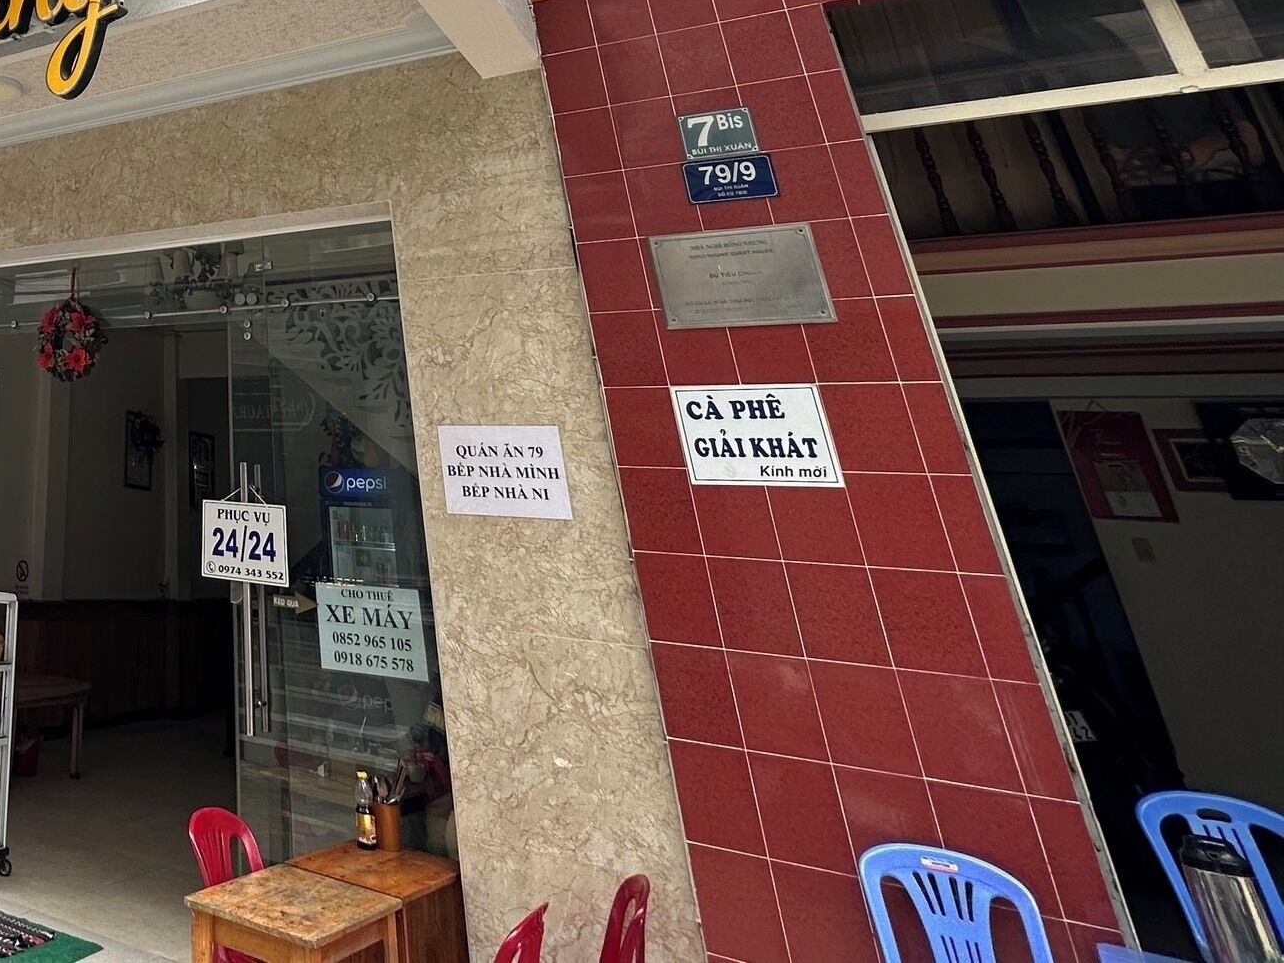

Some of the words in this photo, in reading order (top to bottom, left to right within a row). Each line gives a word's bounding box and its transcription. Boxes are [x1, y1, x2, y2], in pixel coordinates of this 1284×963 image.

[687, 115, 714, 147] 7
[716, 112, 744, 130] Bis
[698, 161, 756, 185] 79/9
[686, 395, 724, 420] CÀ
[729, 393, 785, 419] PHÊ
[456, 442, 498, 460] QUÁN
[503, 443, 524, 458] ĂN
[528, 446, 544, 458] 79
[694, 428, 747, 458] GIẢI
[748, 431, 818, 458] KHÁT
[447, 461, 474, 477] BẾP
[479, 463, 512, 478] NHÀ
[516, 464, 560, 479] MÌNH
[760, 465, 794, 477] Kính
[799, 466, 827, 478] mời
[346, 477, 386, 493] pepsi
[462, 482, 490, 498] BẾP
[494, 484, 528, 500] NHÀ
[533, 488, 550, 500] NI
[217, 508, 250, 526] PHỤC
[253, 512, 271, 526] VỤ
[212, 525, 276, 563] 24/24
[218, 565, 241, 576] 0974
[244, 567, 262, 578] 343
[266, 570, 284, 580] 552
[341, 589, 364, 599] CHO
[367, 589, 394, 602] THUÊ
[326, 604, 356, 624] XE
[362, 604, 414, 630] MÁY
[332, 631, 360, 646] 0852
[364, 634, 387, 649] 965
[390, 637, 412, 652] 105
[334, 650, 363, 666] 0918
[366, 653, 388, 669] 675
[392, 657, 414, 672] 578
